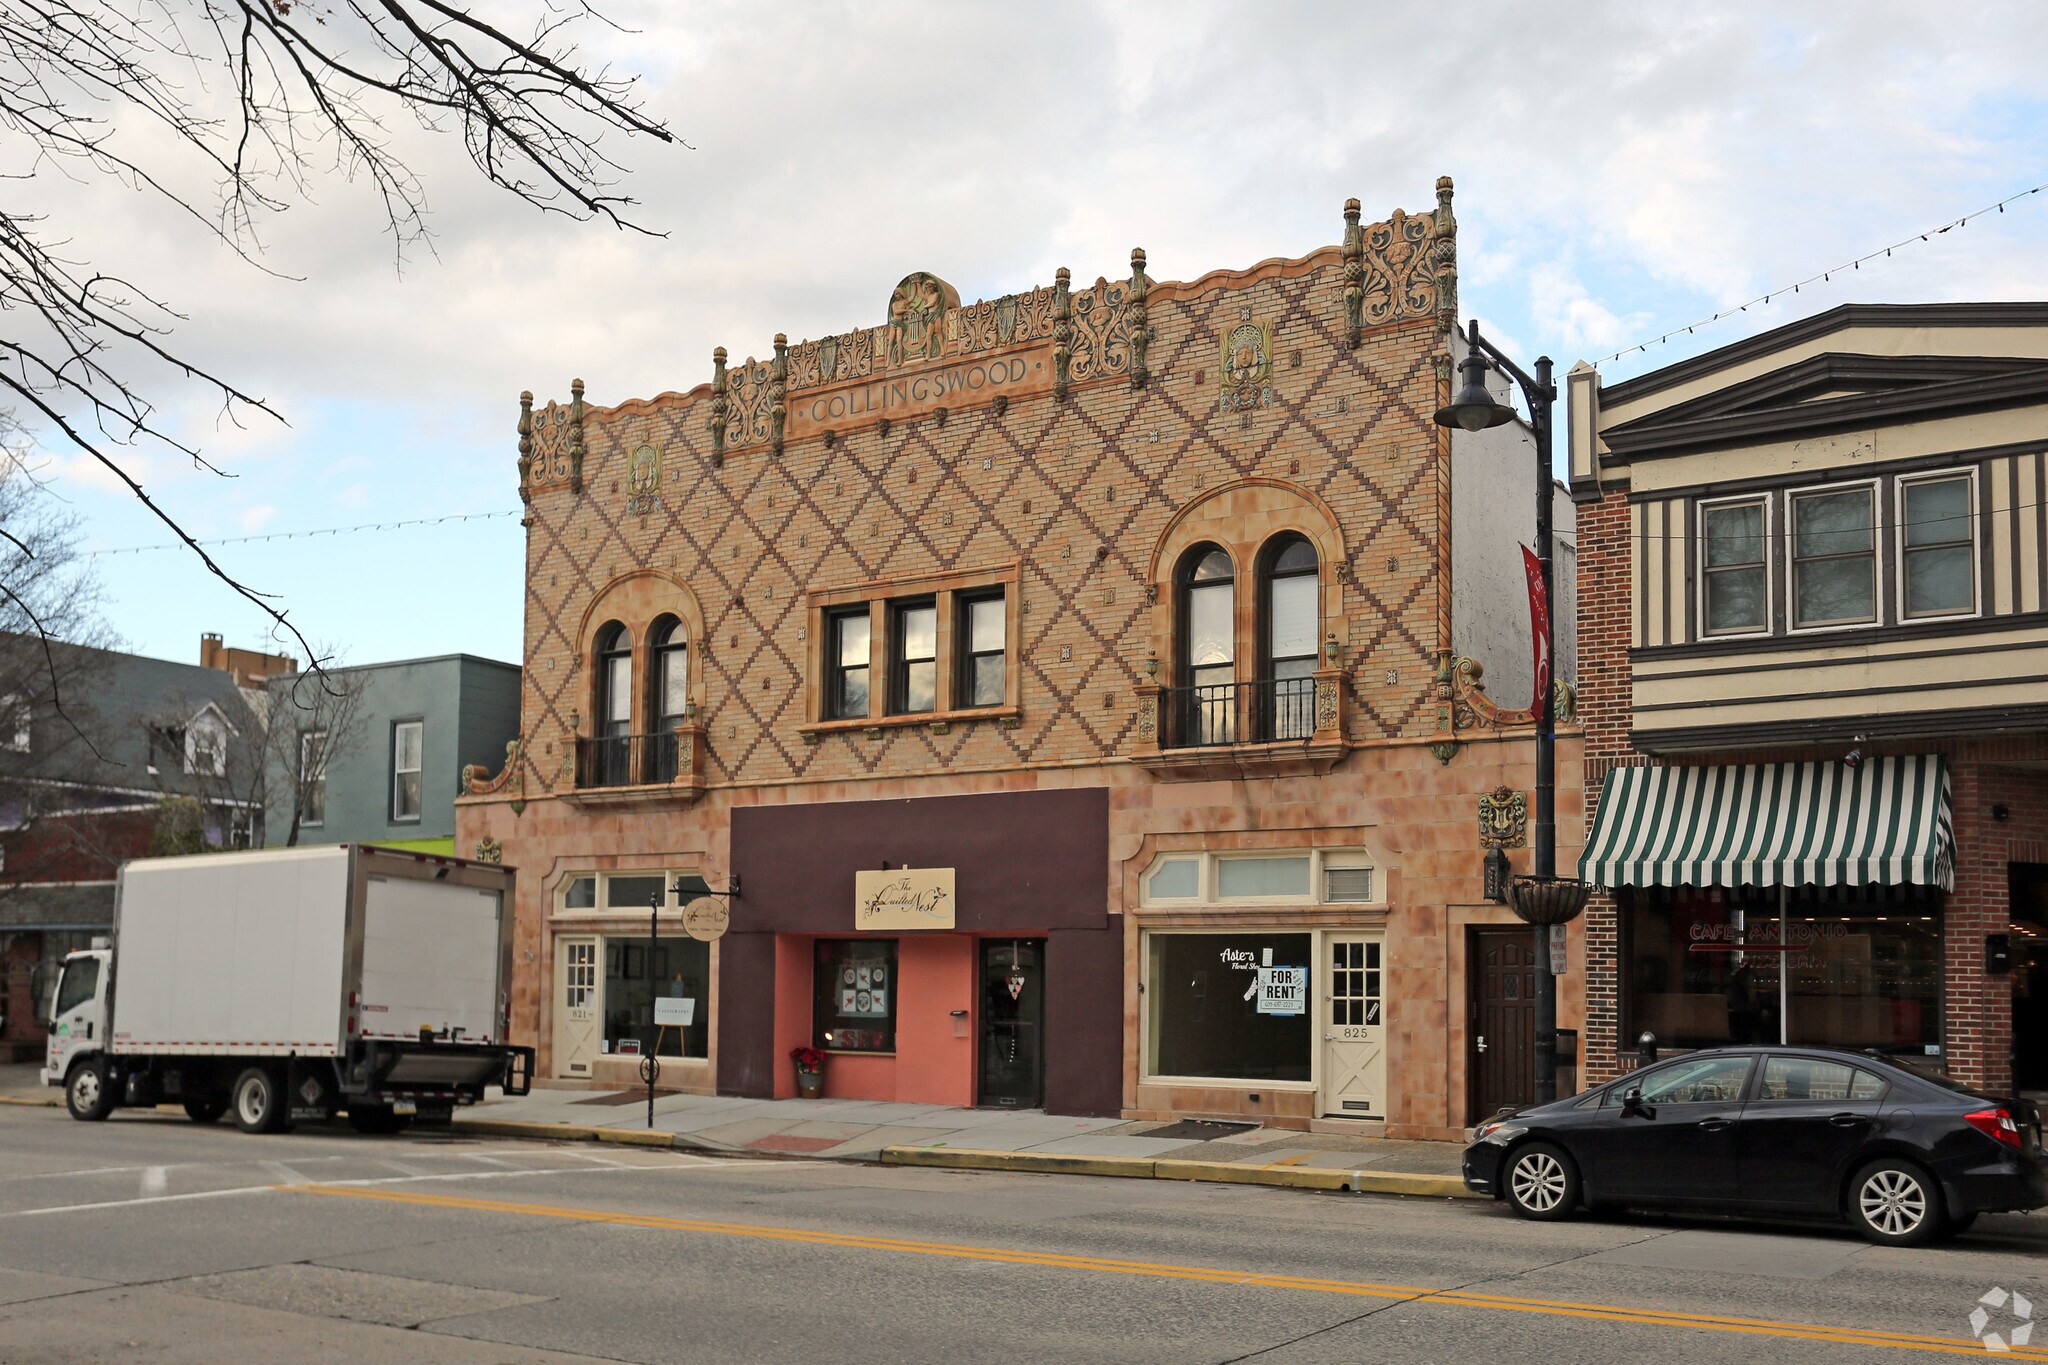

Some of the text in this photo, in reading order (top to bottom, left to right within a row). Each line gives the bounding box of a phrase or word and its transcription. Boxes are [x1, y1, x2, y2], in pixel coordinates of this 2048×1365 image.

[811, 358, 1027, 422] COLLINGSWOOD
[898, 877, 912, 892] The
[876, 884, 939, 912] Quilted Nest
[1689, 923, 1849, 943] CAFE ANTONIO
[1231, 962, 1249, 971] Floral
[1271, 970, 1292, 984] FOR
[1266, 985, 1296, 999] RENT
[572, 1010, 586, 1019] 821
[1344, 1027, 1368, 1038] 825
